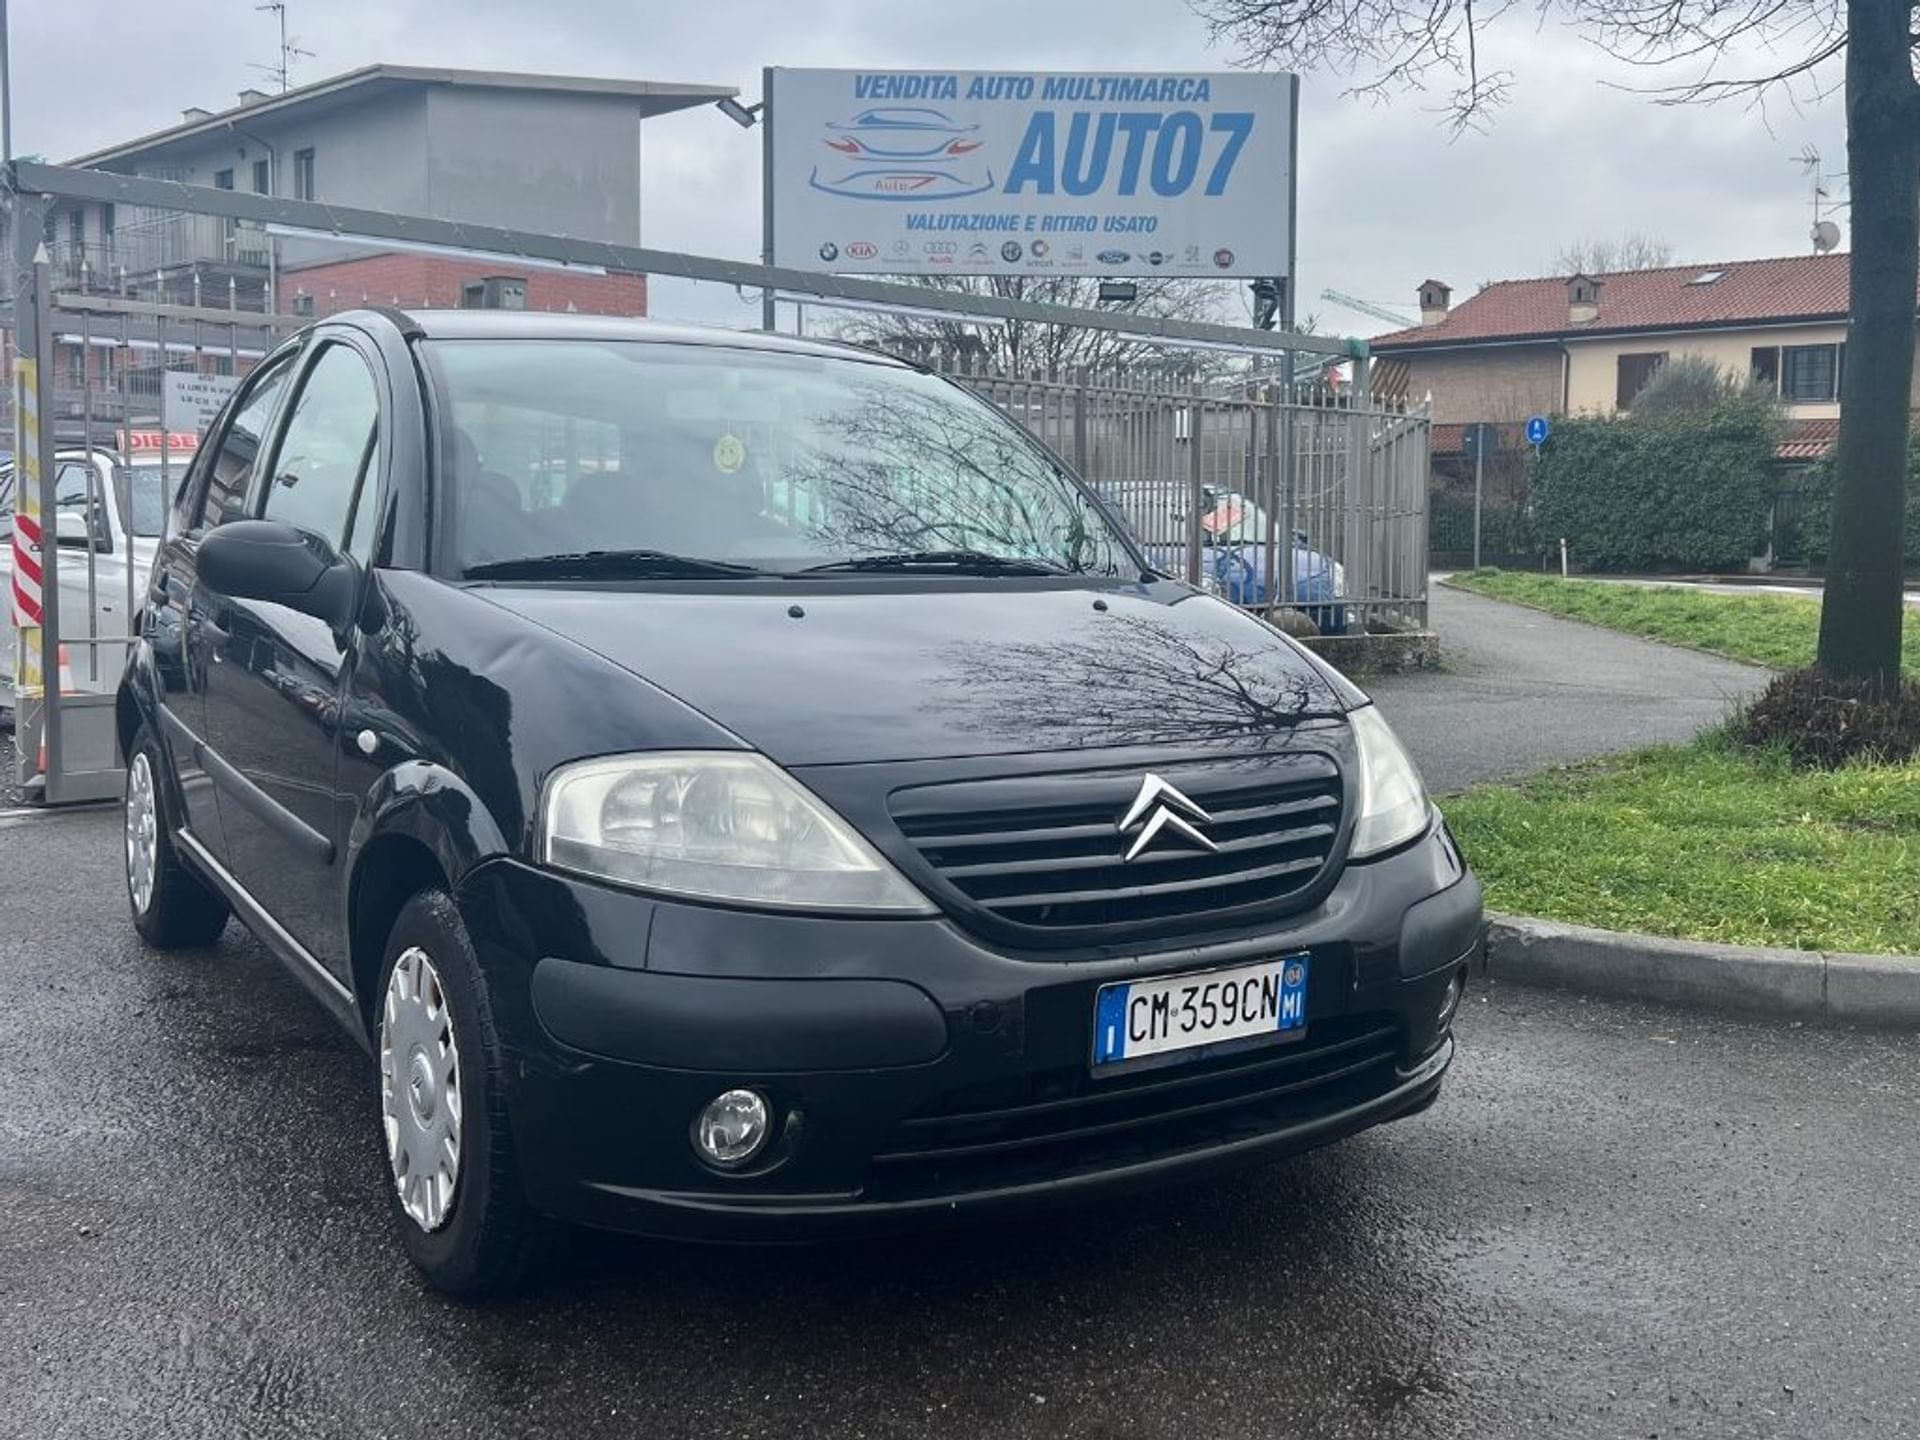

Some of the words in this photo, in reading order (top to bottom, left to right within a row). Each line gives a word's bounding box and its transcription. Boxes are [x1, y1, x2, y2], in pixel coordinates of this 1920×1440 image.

[855, 74, 957, 99] VENDITA
[966, 76, 1034, 100] AUTO
[1042, 77, 1210, 101] MULTIMARCA
[1003, 111, 1255, 196] AUTO7
[906, 214, 1019, 231] VALUTAZIONE
[1024, 215, 1036, 231] E
[1041, 215, 1098, 232] RITIRO
[1103, 216, 1158, 233] USATO
[130, 434, 199, 448] DIESE
[1129, 991, 1169, 1042] CM
[1180, 973, 1280, 1033] 359CN
[1282, 992, 1302, 1020] MI
